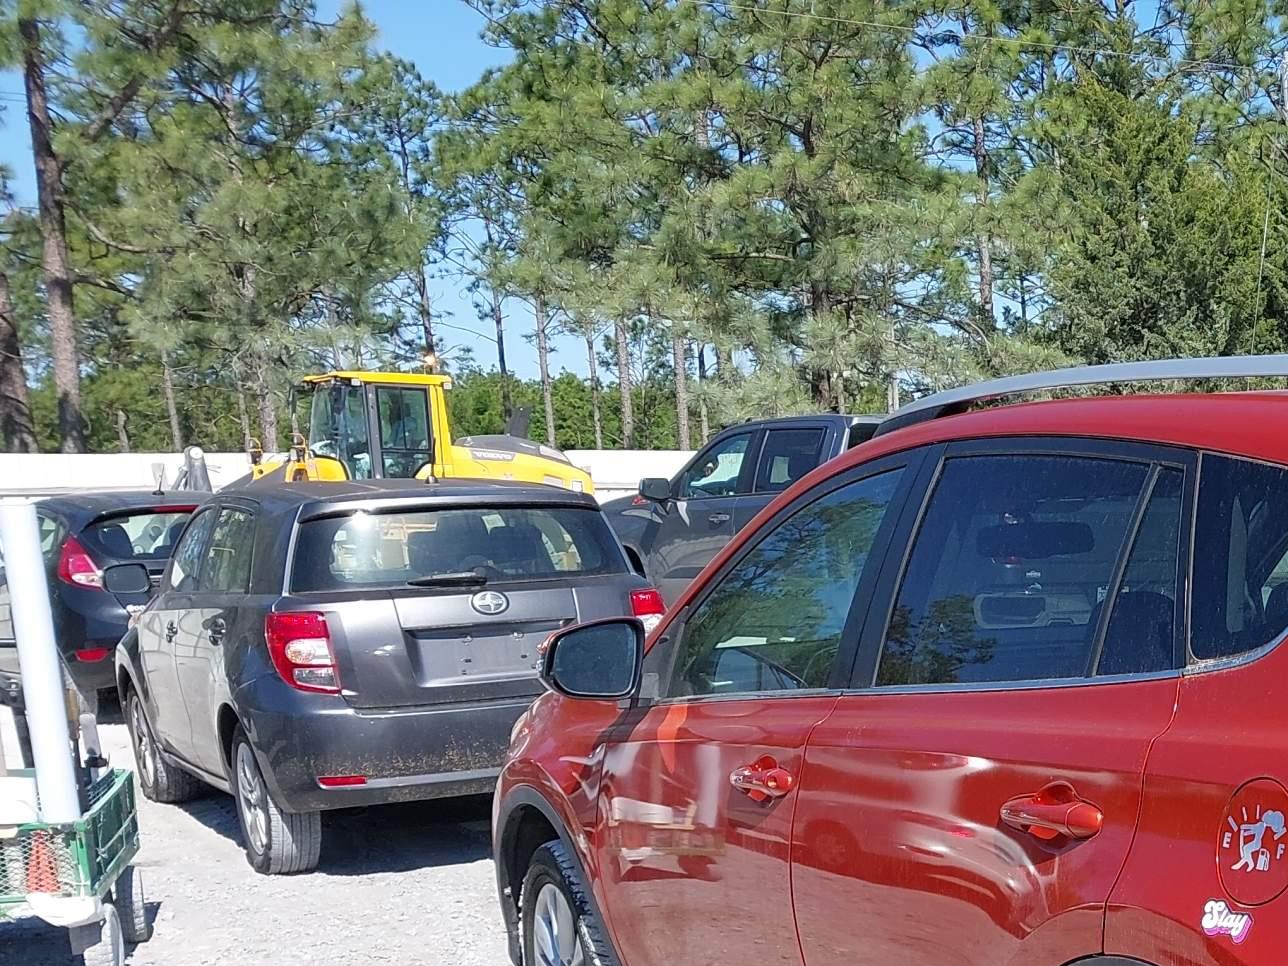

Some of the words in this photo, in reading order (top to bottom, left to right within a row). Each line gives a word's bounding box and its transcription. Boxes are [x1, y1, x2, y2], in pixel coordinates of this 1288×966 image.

[1222, 831, 1232, 849] E
[1276, 843, 1285, 860] F
[1201, 899, 1253, 943] Slay
